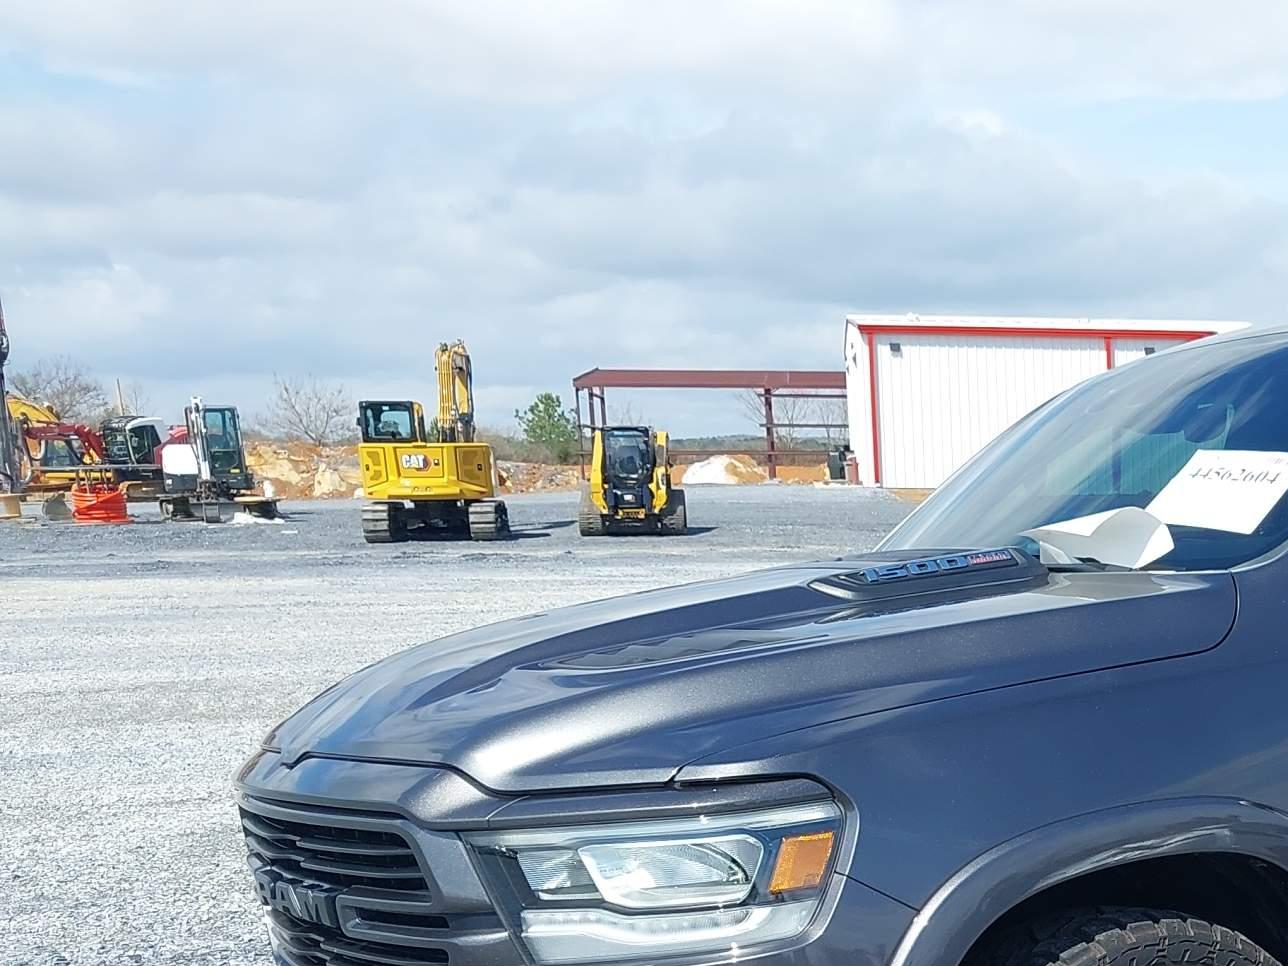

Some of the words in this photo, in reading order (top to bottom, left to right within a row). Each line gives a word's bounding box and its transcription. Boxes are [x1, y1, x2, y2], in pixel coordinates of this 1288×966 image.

[402, 453, 425, 469] CAT
[1189, 466, 1282, 485] 44562604
[861, 556, 969, 583] 1500
[254, 866, 334, 928] RAM
